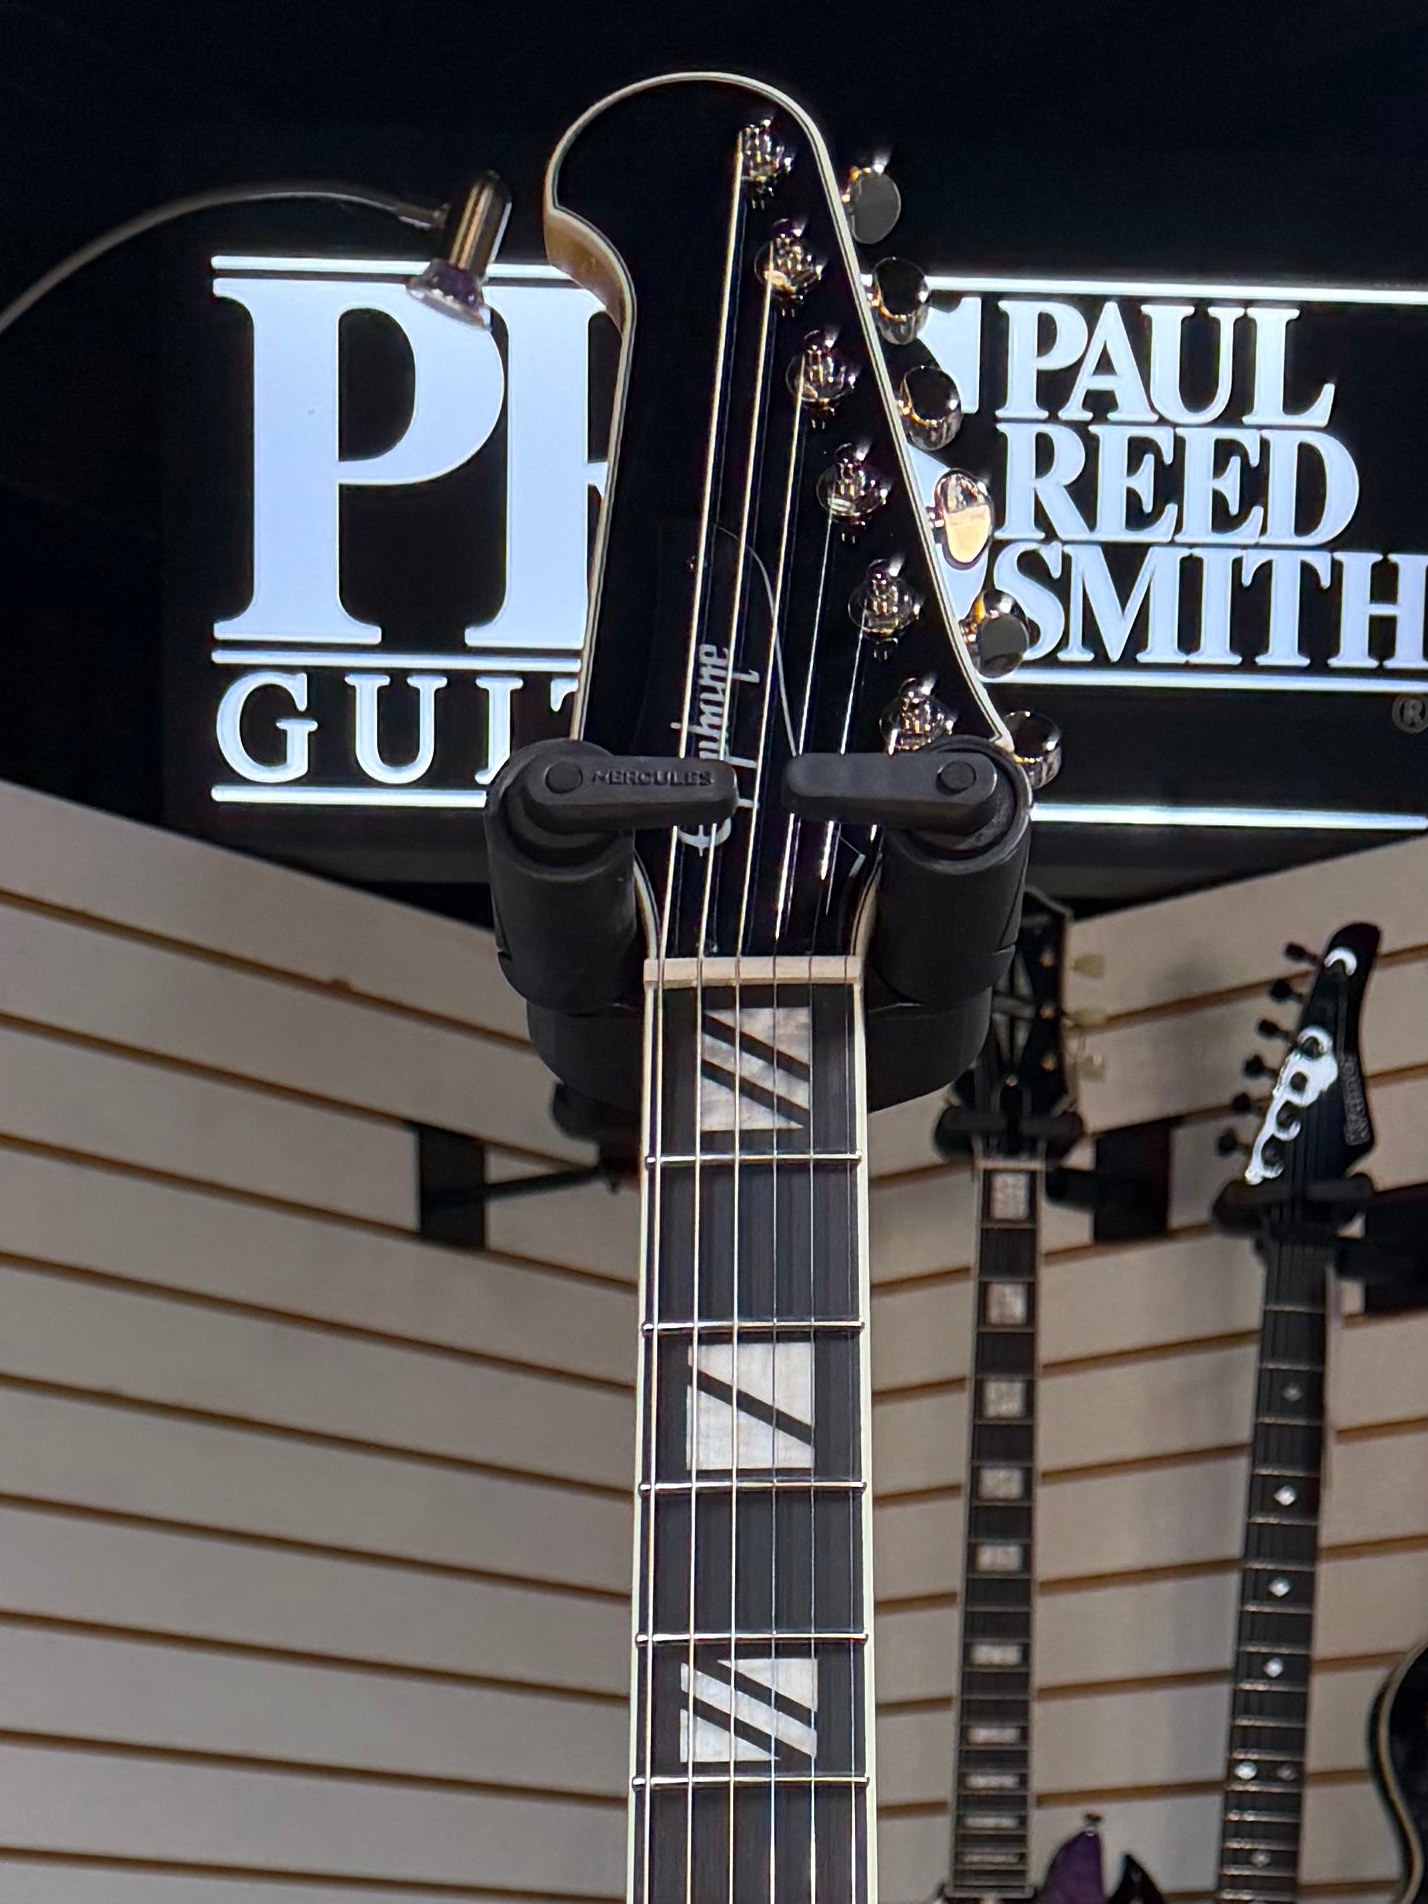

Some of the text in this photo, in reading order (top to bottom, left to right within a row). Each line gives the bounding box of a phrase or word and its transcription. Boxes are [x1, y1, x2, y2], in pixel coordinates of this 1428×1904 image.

[995, 299, 1336, 428] PAUL
[993, 421, 1360, 547] REED
[591, 770, 715, 788] HERCULES
